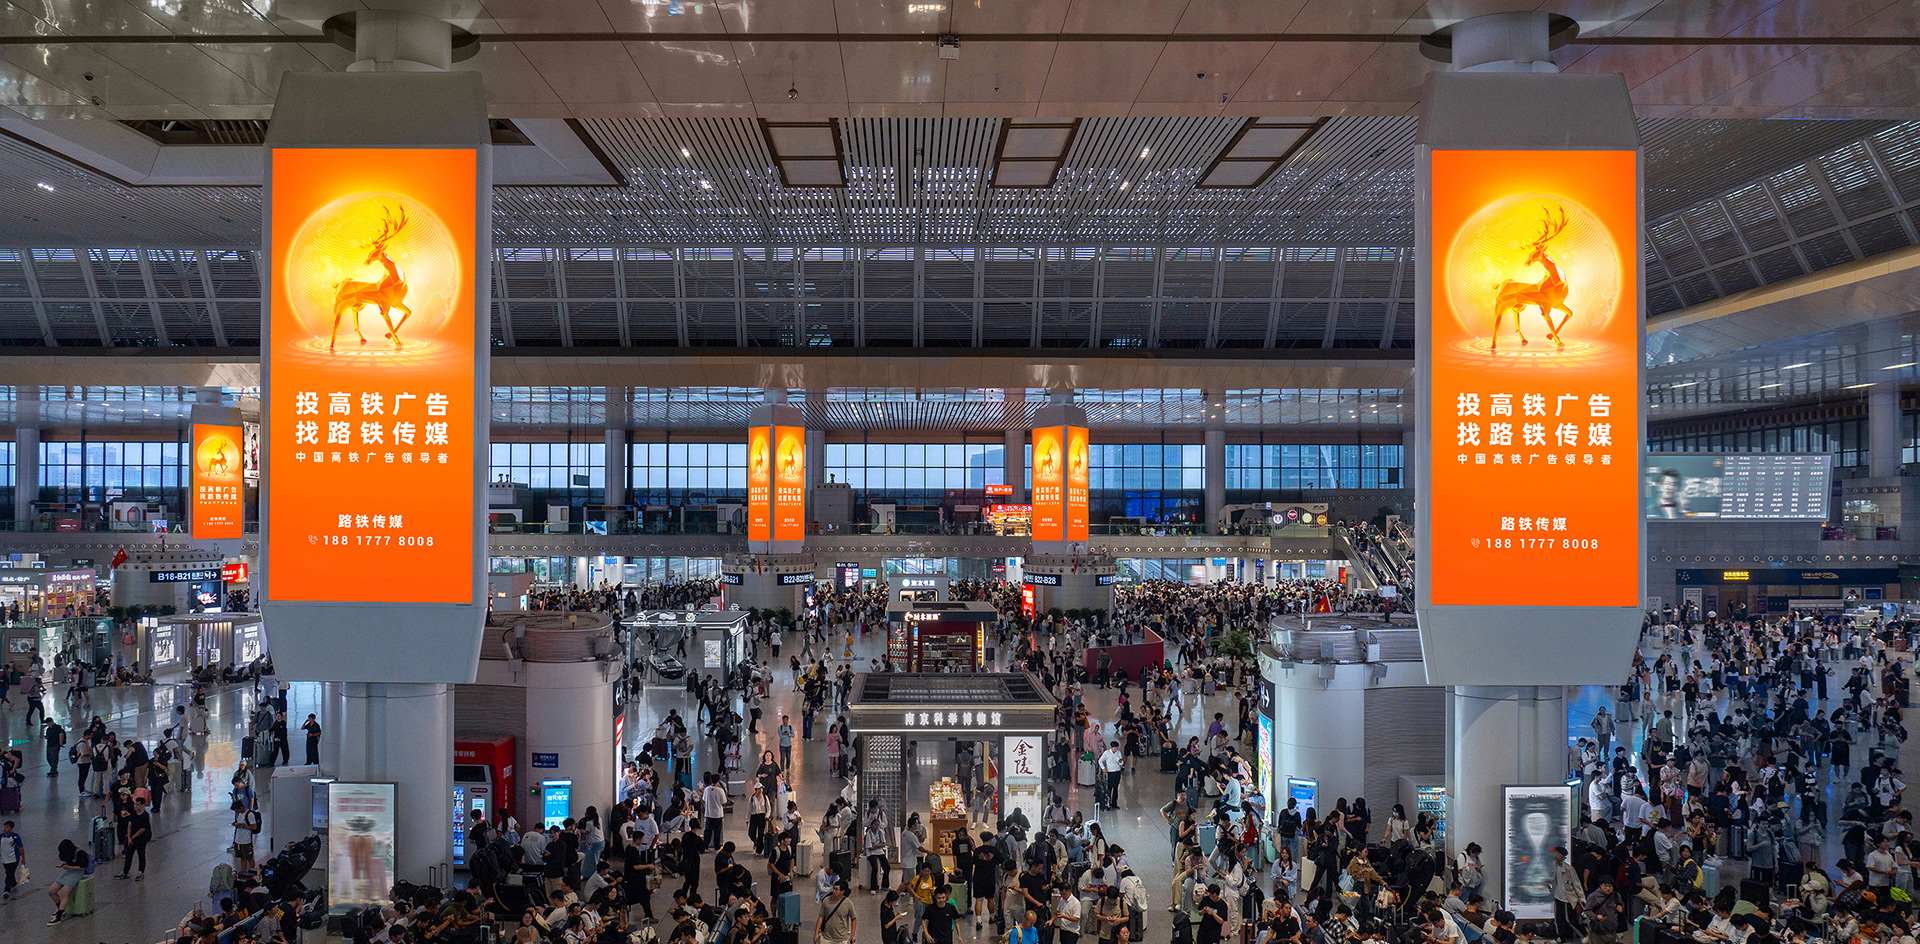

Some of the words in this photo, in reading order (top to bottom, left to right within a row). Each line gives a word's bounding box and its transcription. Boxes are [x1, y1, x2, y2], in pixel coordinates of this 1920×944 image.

[295, 391, 449, 416] 投高铁广告
[1456, 392, 1612, 417] 投高铁广告
[295, 420, 449, 446] 找路铁传媒
[1456, 421, 1613, 447] 找路铁传媒
[295, 451, 449, 464] 中国高铁广告领导者
[1457, 453, 1612, 466] 中国高铁广告领导者
[337, 513, 403, 529] 路铁传媒
[1500, 516, 1567, 532] 路铁传媒
[323, 535, 349, 547] 188
[356, 536, 391, 547] 1777
[398, 536, 434, 547] 8008
[1486, 538, 1512, 550] 188
[1519, 538, 1555, 550] 1777
[1562, 538, 1599, 550] 8008
[157, 572, 191, 580] B18-B21
[904, 712, 1002, 726] 南京科举博物馆
[1012, 739, 1034, 775] 金陵
